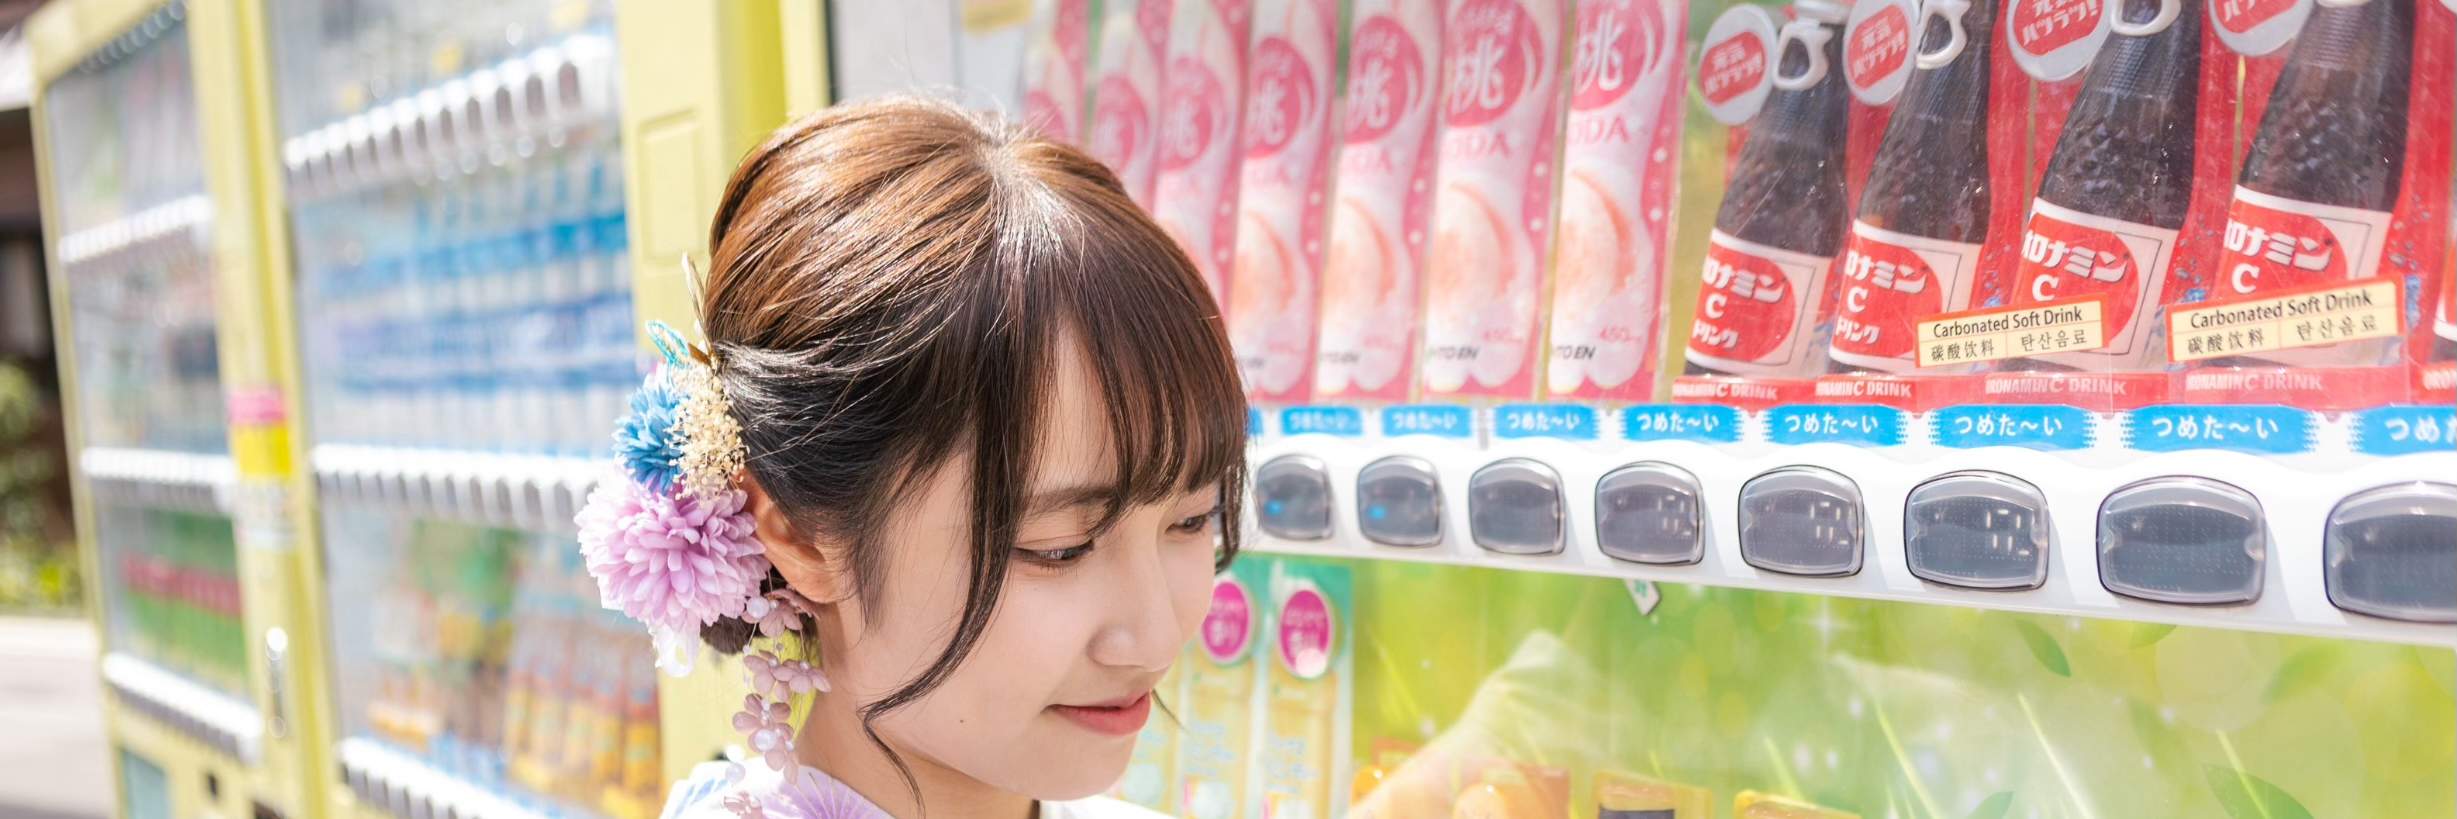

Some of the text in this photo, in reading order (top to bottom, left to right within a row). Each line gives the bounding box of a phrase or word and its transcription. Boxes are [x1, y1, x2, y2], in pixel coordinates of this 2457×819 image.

[1575, 9, 1625, 97] 桃
[1451, 35, 1506, 115] 桃
[1349, 57, 1394, 131] 桃
[2032, 273, 2060, 302] C
[2231, 263, 2261, 294] C
[1705, 293, 1728, 319] C
[1847, 286, 1869, 313] C
[2190, 289, 2374, 330] Carbonated Soft Drink
[1933, 306, 2083, 339] Carbonated Soft Drink
[1930, 339, 1995, 362] 碳酸饮料
[2020, 329, 2088, 353] 탄산음료
[2186, 329, 2265, 355] 碳酸饮料
[1731, 384, 1779, 400] DRINK
[1854, 380, 1865, 396] C
[1867, 381, 1913, 398] DRINK
[2049, 377, 2065, 393] C
[2069, 378, 2127, 395] DRINK
[2244, 374, 2260, 391] C
[2264, 374, 2323, 391] DRINK
